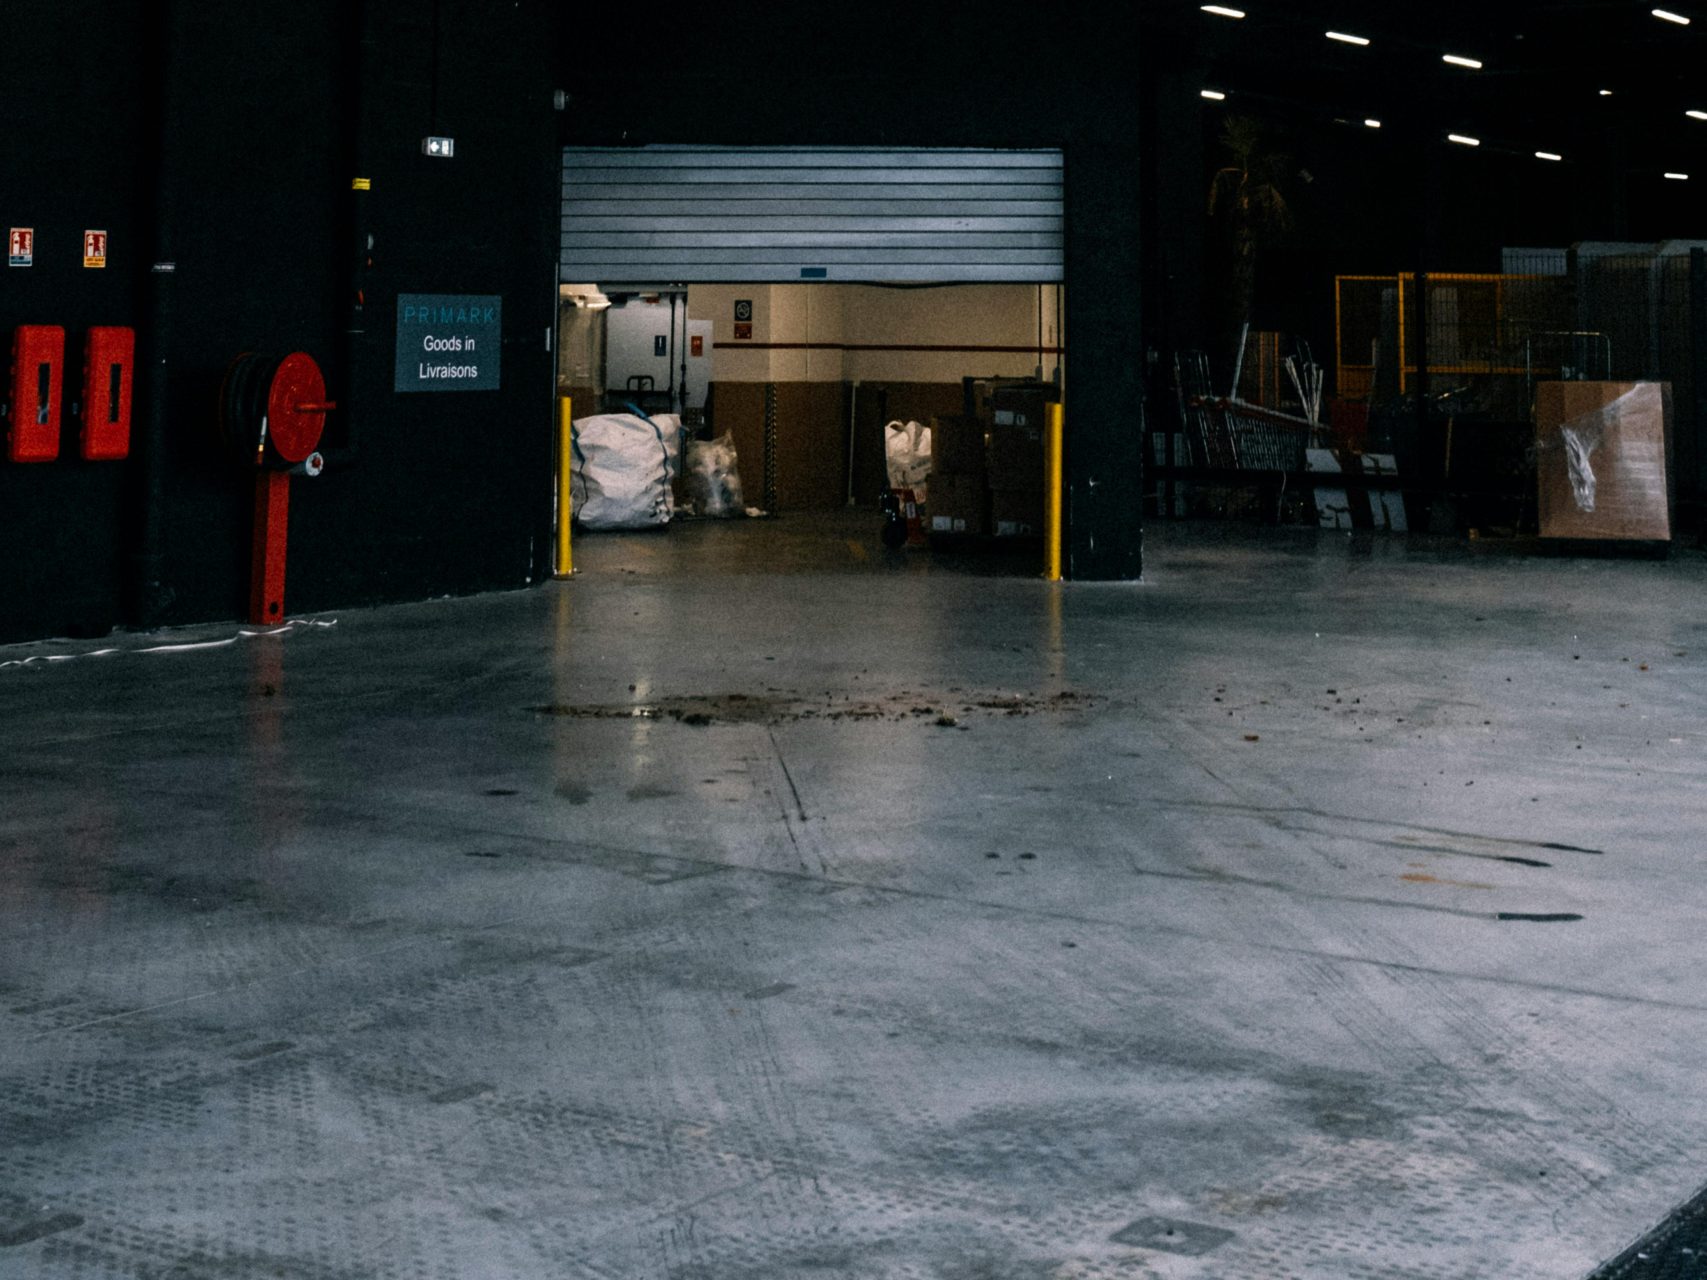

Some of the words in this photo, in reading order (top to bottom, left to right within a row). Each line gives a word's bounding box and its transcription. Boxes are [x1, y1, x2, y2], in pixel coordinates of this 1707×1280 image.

[404, 306, 494, 323] PRIMARK
[423, 335, 462, 351] Goods
[465, 335, 475, 351] in
[419, 363, 478, 378] Livraisons
